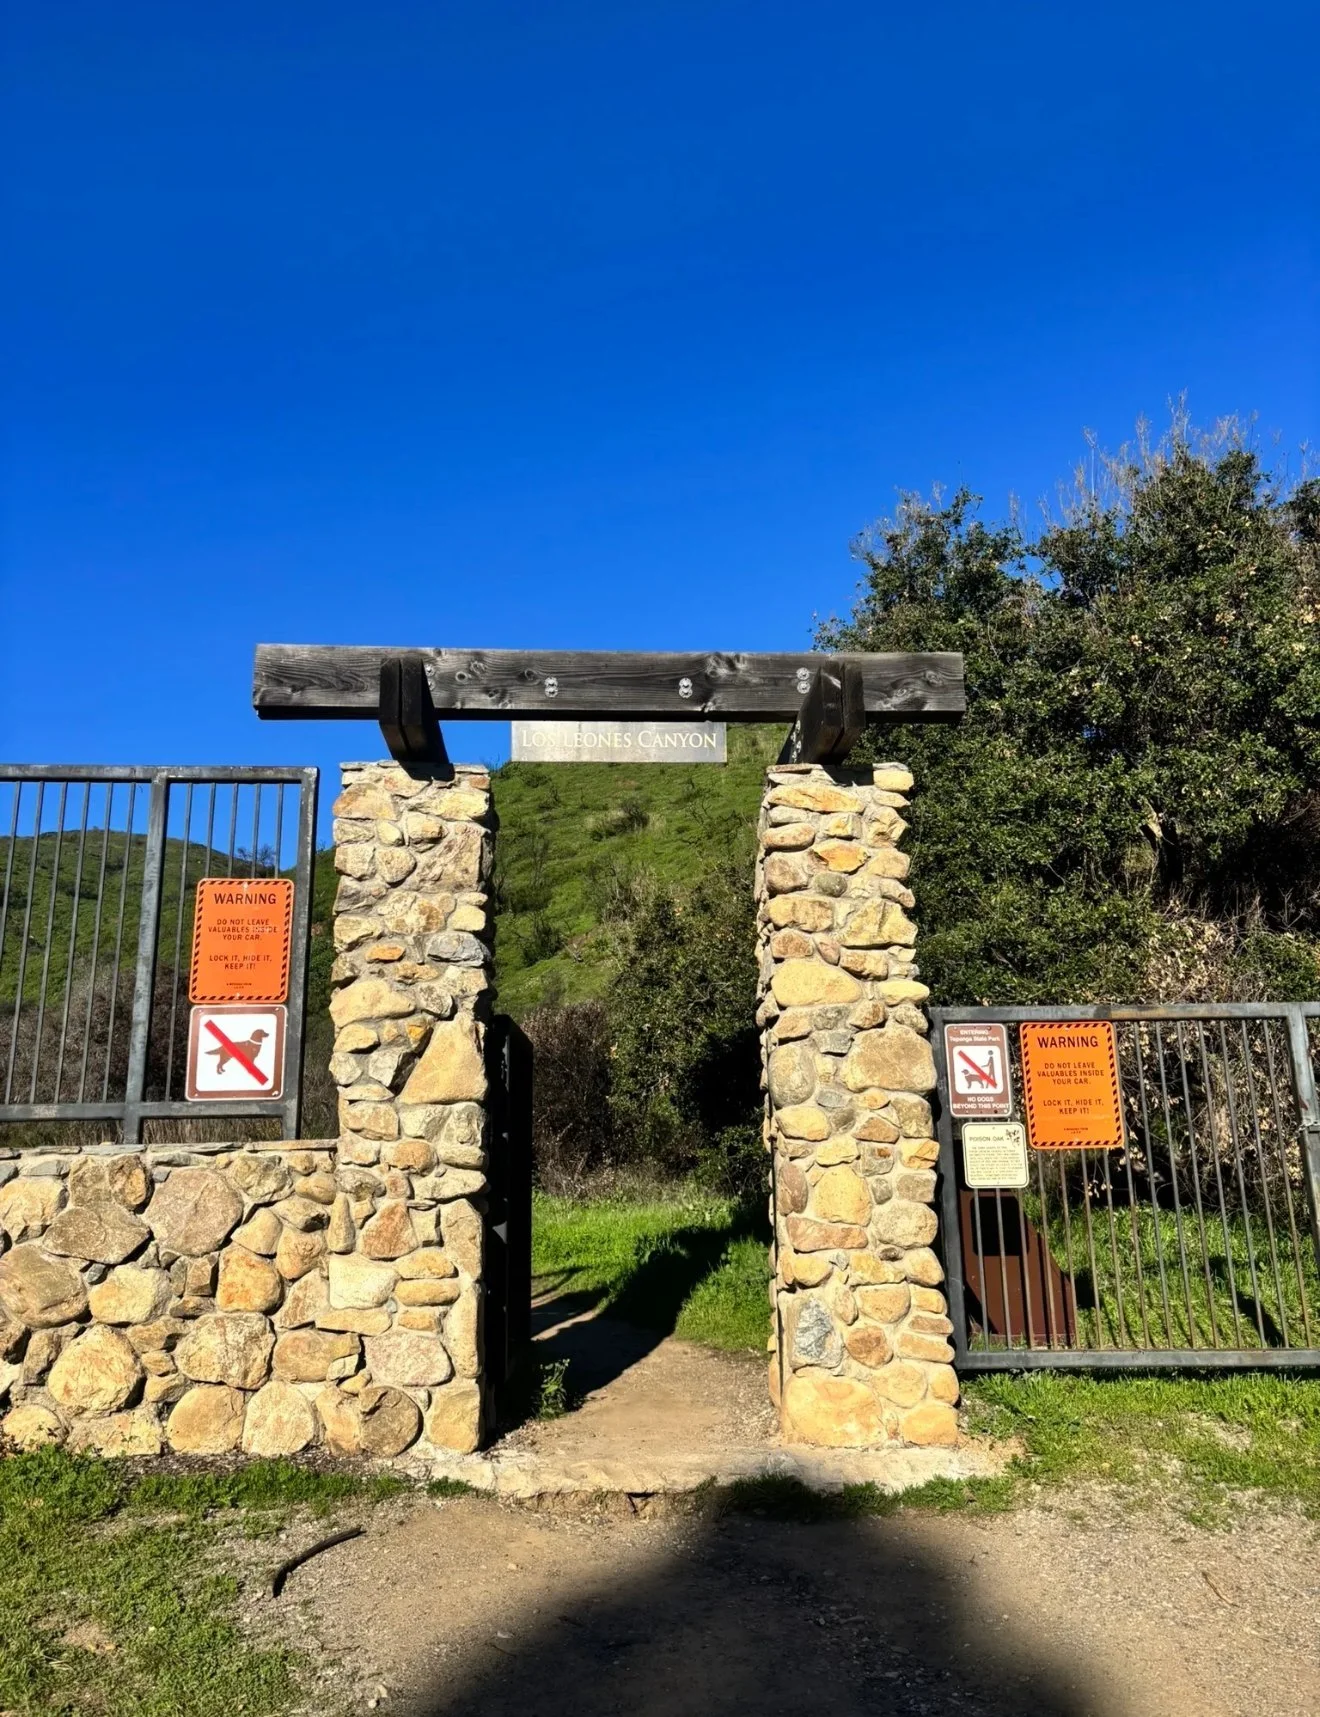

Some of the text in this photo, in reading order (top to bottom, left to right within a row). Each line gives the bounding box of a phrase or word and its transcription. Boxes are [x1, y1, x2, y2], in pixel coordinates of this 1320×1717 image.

[521, 729, 717, 748] LOS LEONES CANYON
[214, 893, 277, 905] WARNING
[1037, 1036, 1098, 1048] WARNING
